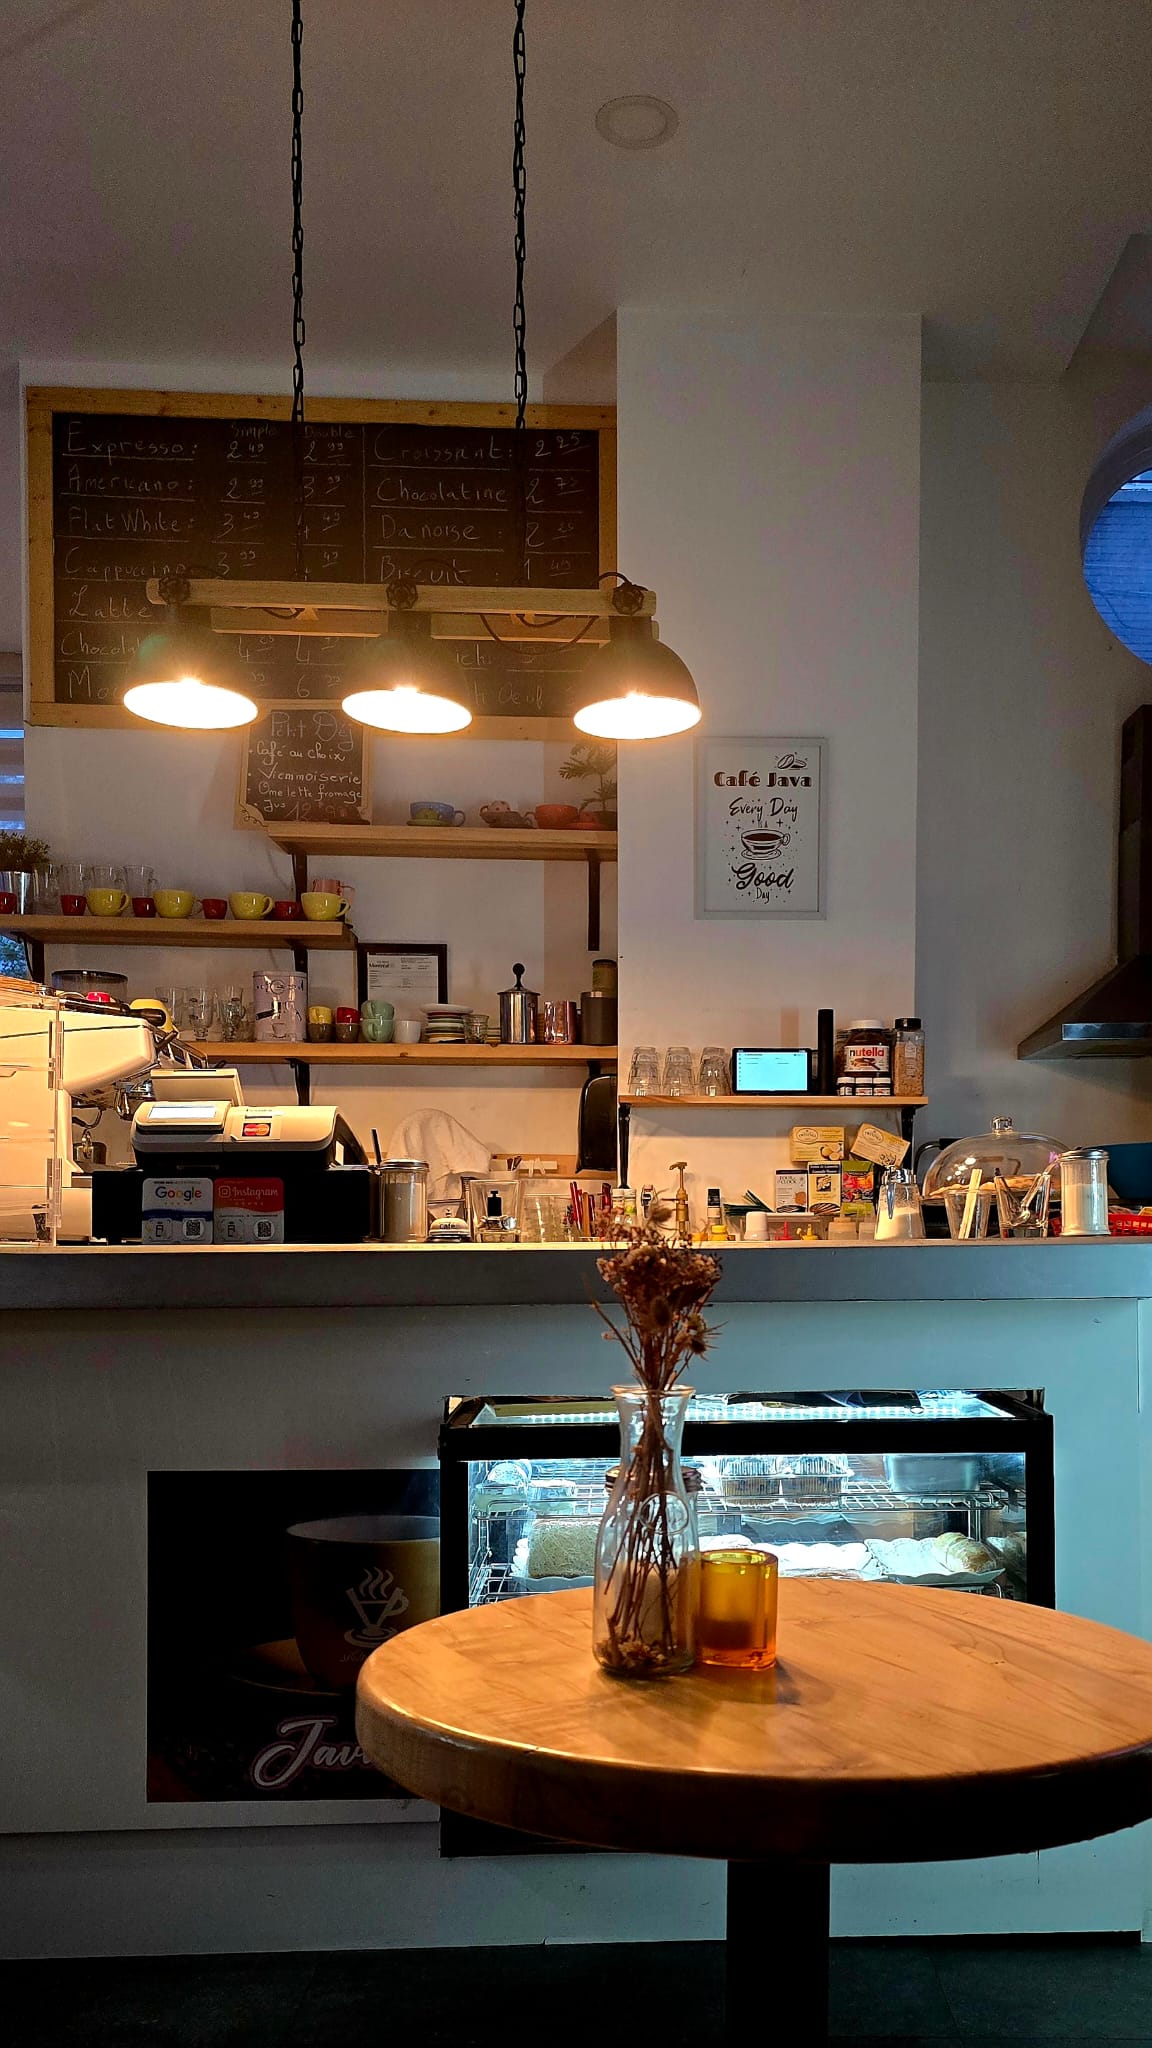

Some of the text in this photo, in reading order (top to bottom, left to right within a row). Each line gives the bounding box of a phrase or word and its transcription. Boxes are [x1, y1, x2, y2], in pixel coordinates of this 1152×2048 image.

[303, 425, 356, 439] Double
[256, 741, 287, 766] Café
[289, 749, 303, 758] au
[714, 770, 812, 788] Café Java
[314, 784, 363, 804] fromage
[728, 797, 798, 822] Every Day
[731, 862, 794, 890] Good
[756, 887, 770, 904] Day
[849, 1046, 885, 1057] nutella
[155, 1186, 203, 1201] Google
[231, 1186, 279, 1200] Instagram
[253, 1716, 371, 1788] Jav
